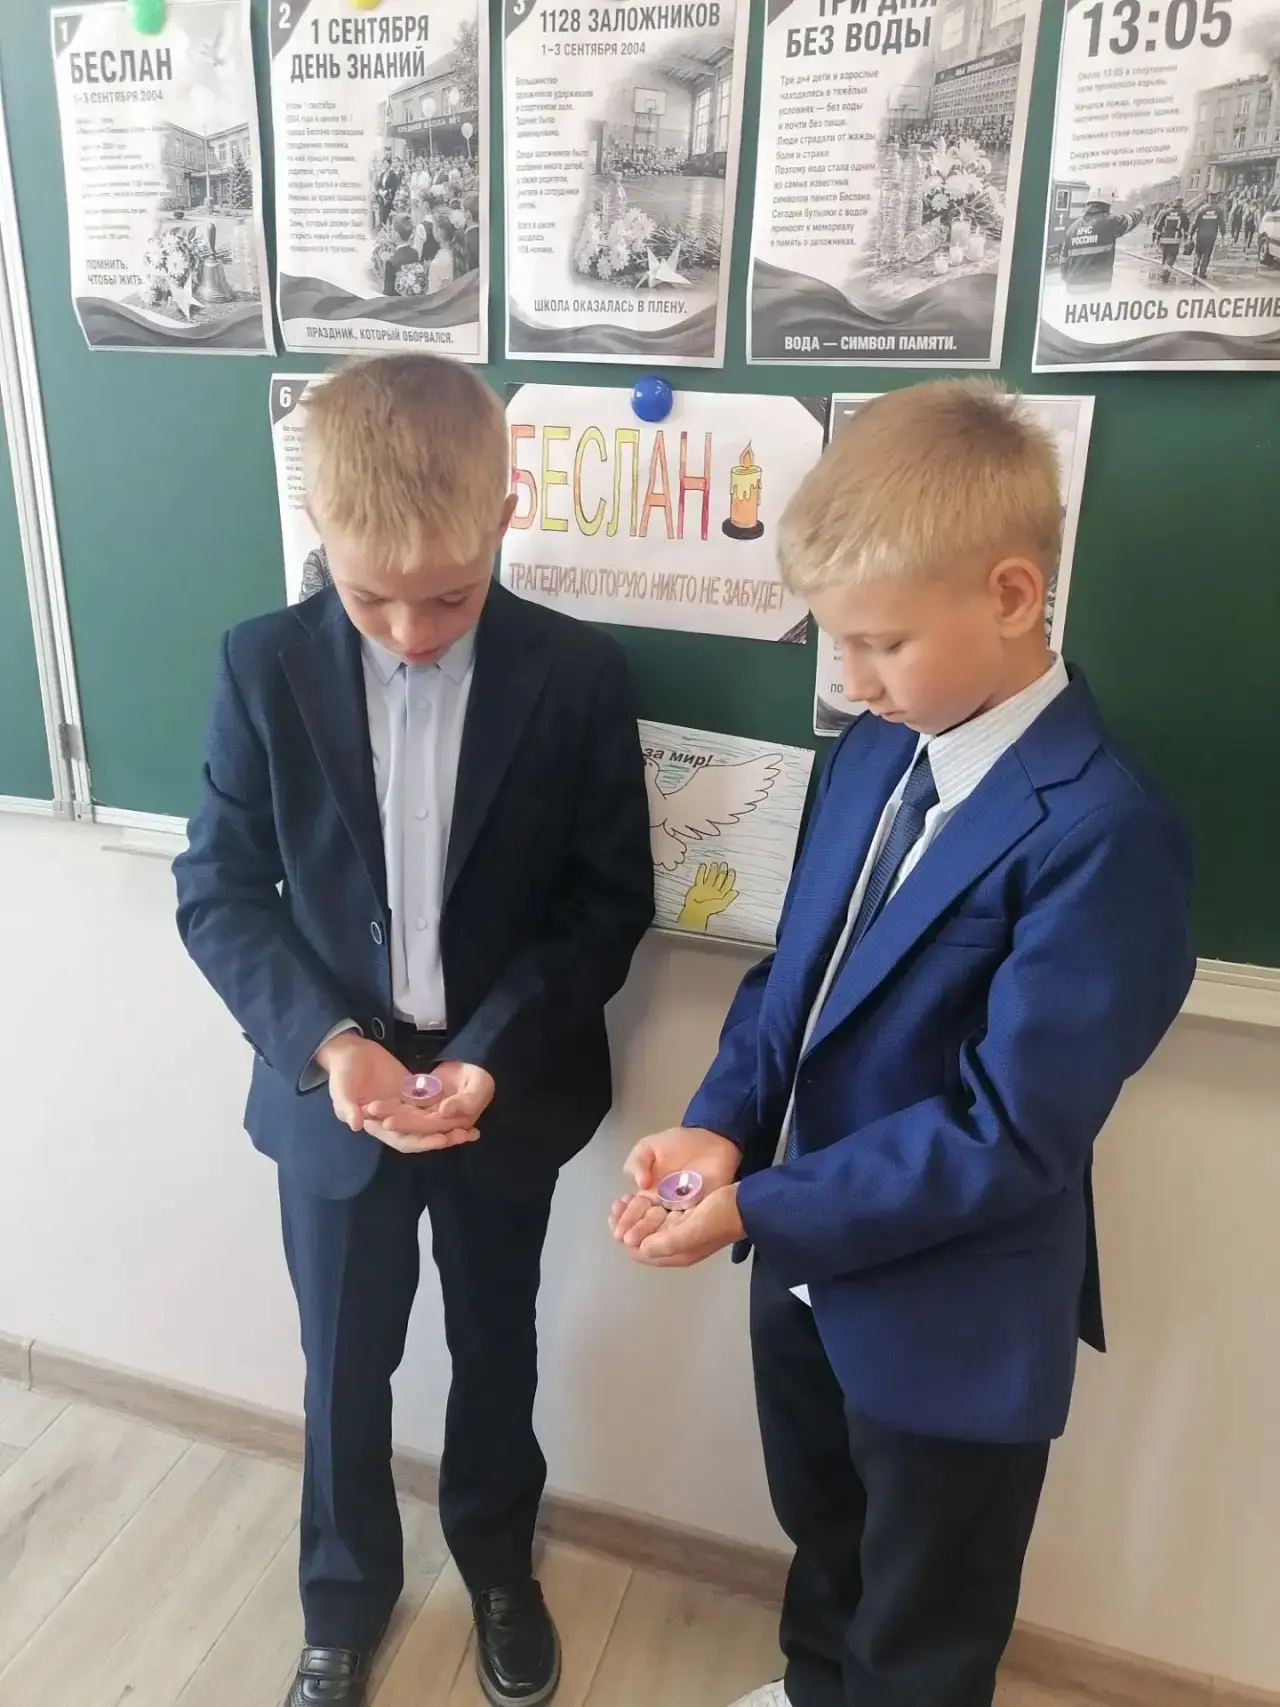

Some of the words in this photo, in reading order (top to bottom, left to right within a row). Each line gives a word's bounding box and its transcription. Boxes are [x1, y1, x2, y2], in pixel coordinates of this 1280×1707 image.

[278, 2, 292, 29] 2
[540, 9, 580, 33] 1128
[588, 3, 720, 33] ЗАЛОЖНИКОВ
[60, 21, 69, 43] 1
[311, 19, 319, 44] 1
[329, 15, 429, 44] СЕНТЯБРЯ
[786, 24, 835, 58] БЕЗ
[845, 16, 931, 55] ВОДЫ
[1083, 0, 1233, 57] 13:05
[564, 43, 617, 56] СЕНТЯБРЯ
[621, 42, 645, 55] 2004
[70, 48, 172, 84] БЕСЛАН
[290, 53, 341, 83] ДЕНЬ
[347, 45, 425, 79] ЗНАНИЙ
[91, 90, 138, 103] СЕНТЯБРЯ
[140, 89, 163, 102] 2004
[826, 102, 840, 112] без
[784, 121, 807, 132] почти
[809, 119, 822, 128] без
[775, 165, 806, 175] Поэтому
[86, 260, 128, 270] ПОМНИТЬ,
[88, 275, 117, 285] ЧТОБЫ
[119, 274, 145, 285] ЖИТЬ.
[534, 299, 570, 313] ШКОЛА
[573, 299, 634, 313] ОКАЗАЛАСЬ
[637, 300, 645, 313] В
[647, 300, 688, 314] ПЛЕНУ.
[1064, 300, 1168, 324] НАЧАЛОСЬ
[1176, 297, 1280, 319] СПАСЕНИЕ
[306, 326, 358, 340] ПРАЗДНИК,
[360, 328, 400, 341] КОТОРЫЙ
[402, 331, 454, 343] ОБОРВАЛСЯ.
[784, 335, 821, 352] ВОДА
[840, 335, 895, 350] СИМВОЛ
[899, 335, 957, 350] ПАМЯТИ.
[279, 387, 292, 407] 6
[510, 424, 712, 541] БЕСЛАН
[650, 572, 697, 602] НИКТО
[701, 576, 721, 605] НЕ
[643, 748, 665, 760] за
[669, 752, 713, 768] мир!
